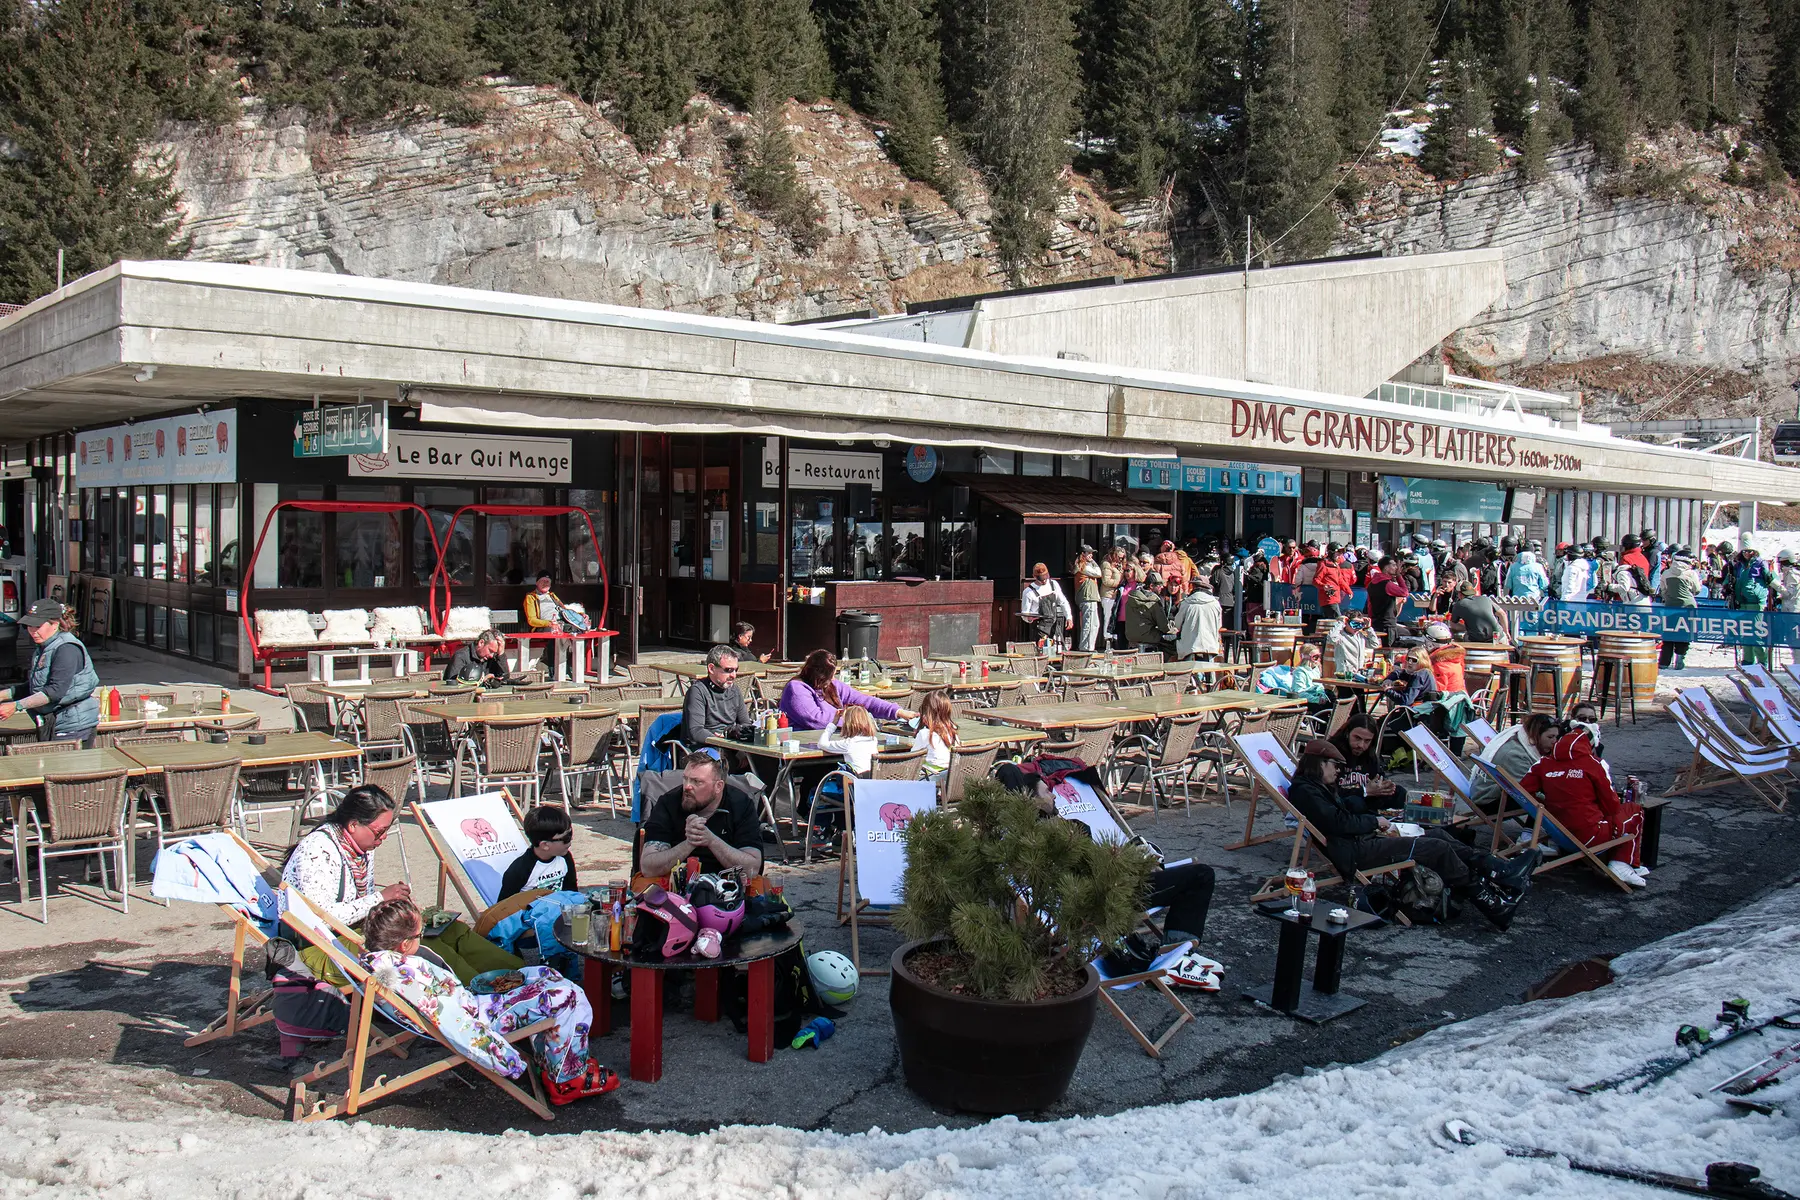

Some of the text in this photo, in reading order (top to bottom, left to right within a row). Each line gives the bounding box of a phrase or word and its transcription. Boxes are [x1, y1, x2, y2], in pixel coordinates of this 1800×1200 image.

[1231, 399, 1296, 444] DMC
[1303, 409, 1415, 457] GRANDES
[1422, 424, 1517, 467] PLATIERES
[397, 445, 569, 476] Le Bar Qui Mange
[1130, 459, 1181, 470] ACCES TOILETTES
[804, 463, 880, 480] Restaurant
[1186, 467, 1206, 476] ECOLES
[1543, 609, 1641, 630] GRANDES
[1649, 614, 1769, 638] PLATIERES
[1182, 973, 1207, 983] ATOMIC
